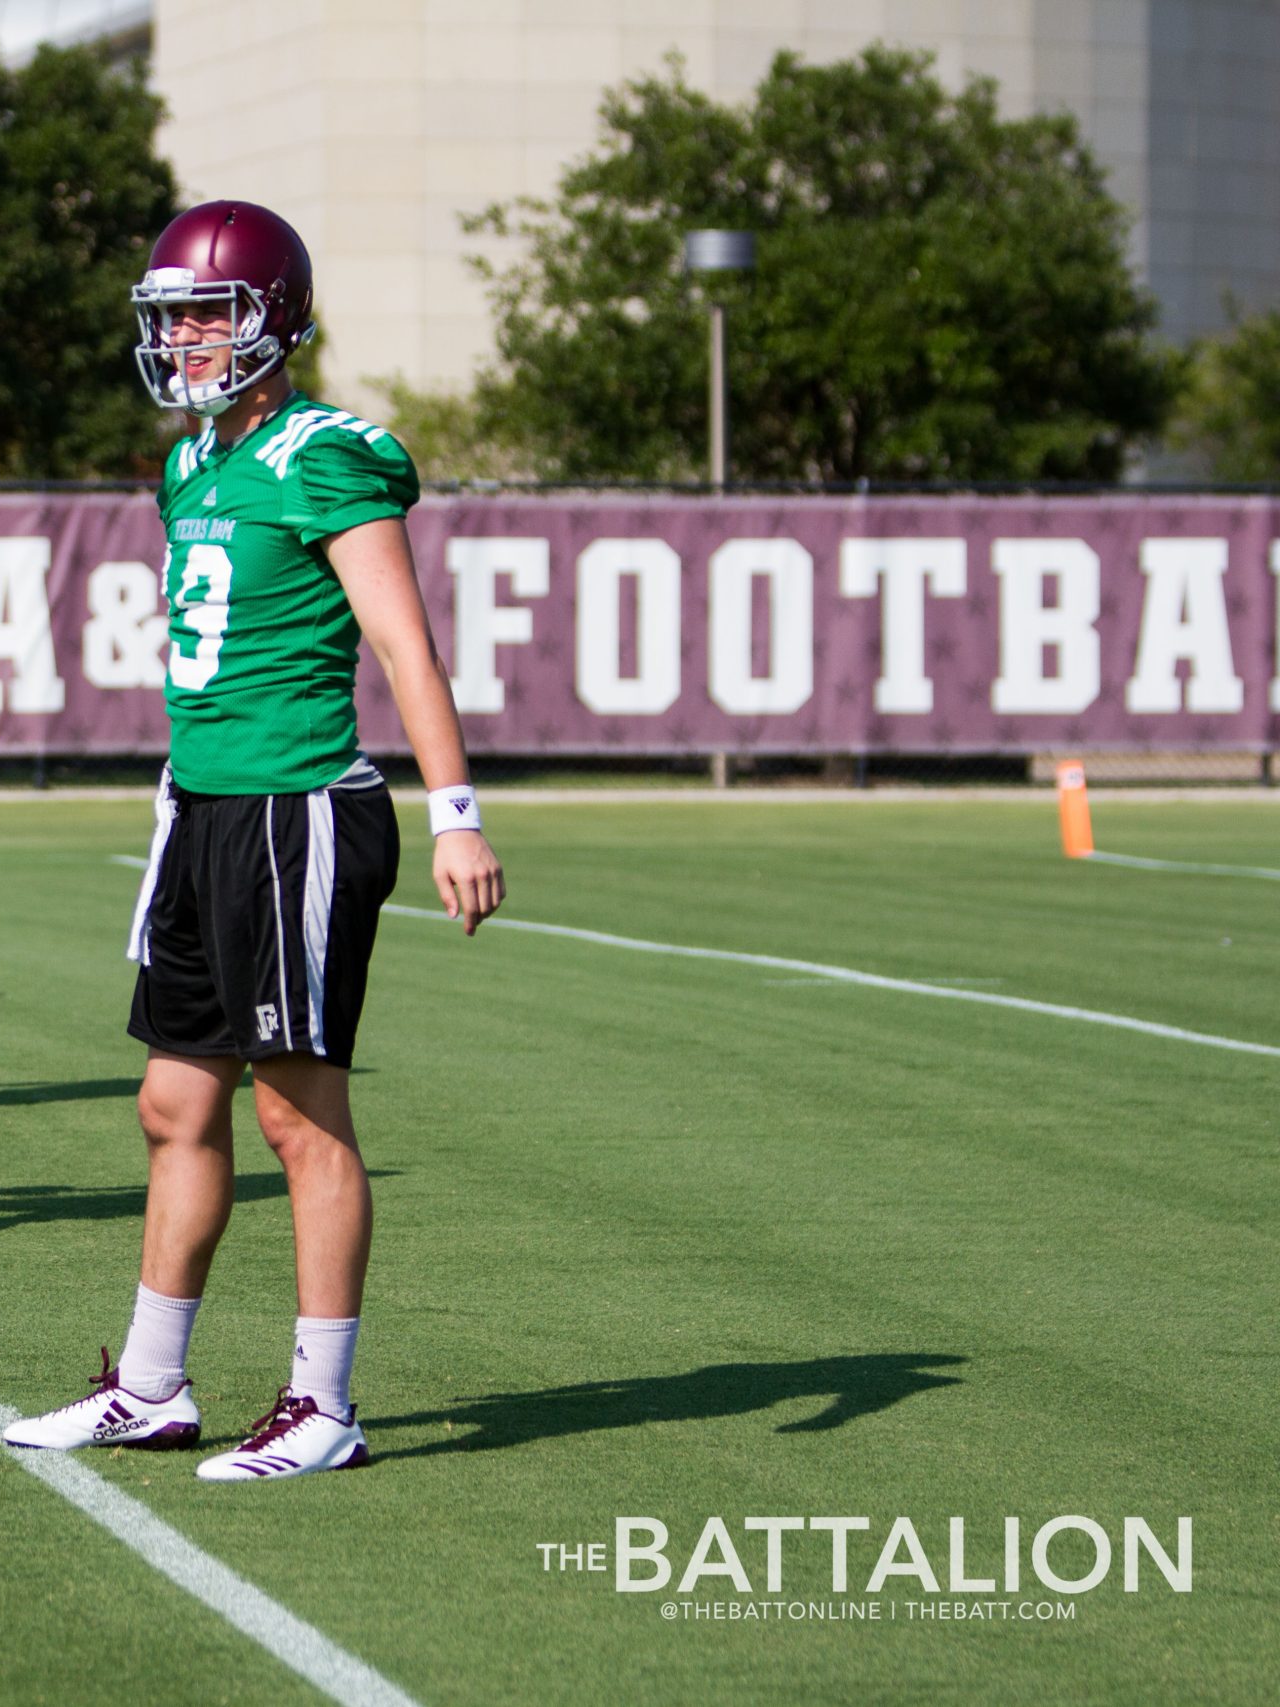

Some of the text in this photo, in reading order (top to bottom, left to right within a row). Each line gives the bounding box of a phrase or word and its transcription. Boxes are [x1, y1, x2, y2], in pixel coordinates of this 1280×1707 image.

[175, 518, 209, 541] TEXAS
[445, 536, 1280, 715] FOOTBA
[93, 1418, 150, 1441] adidas
